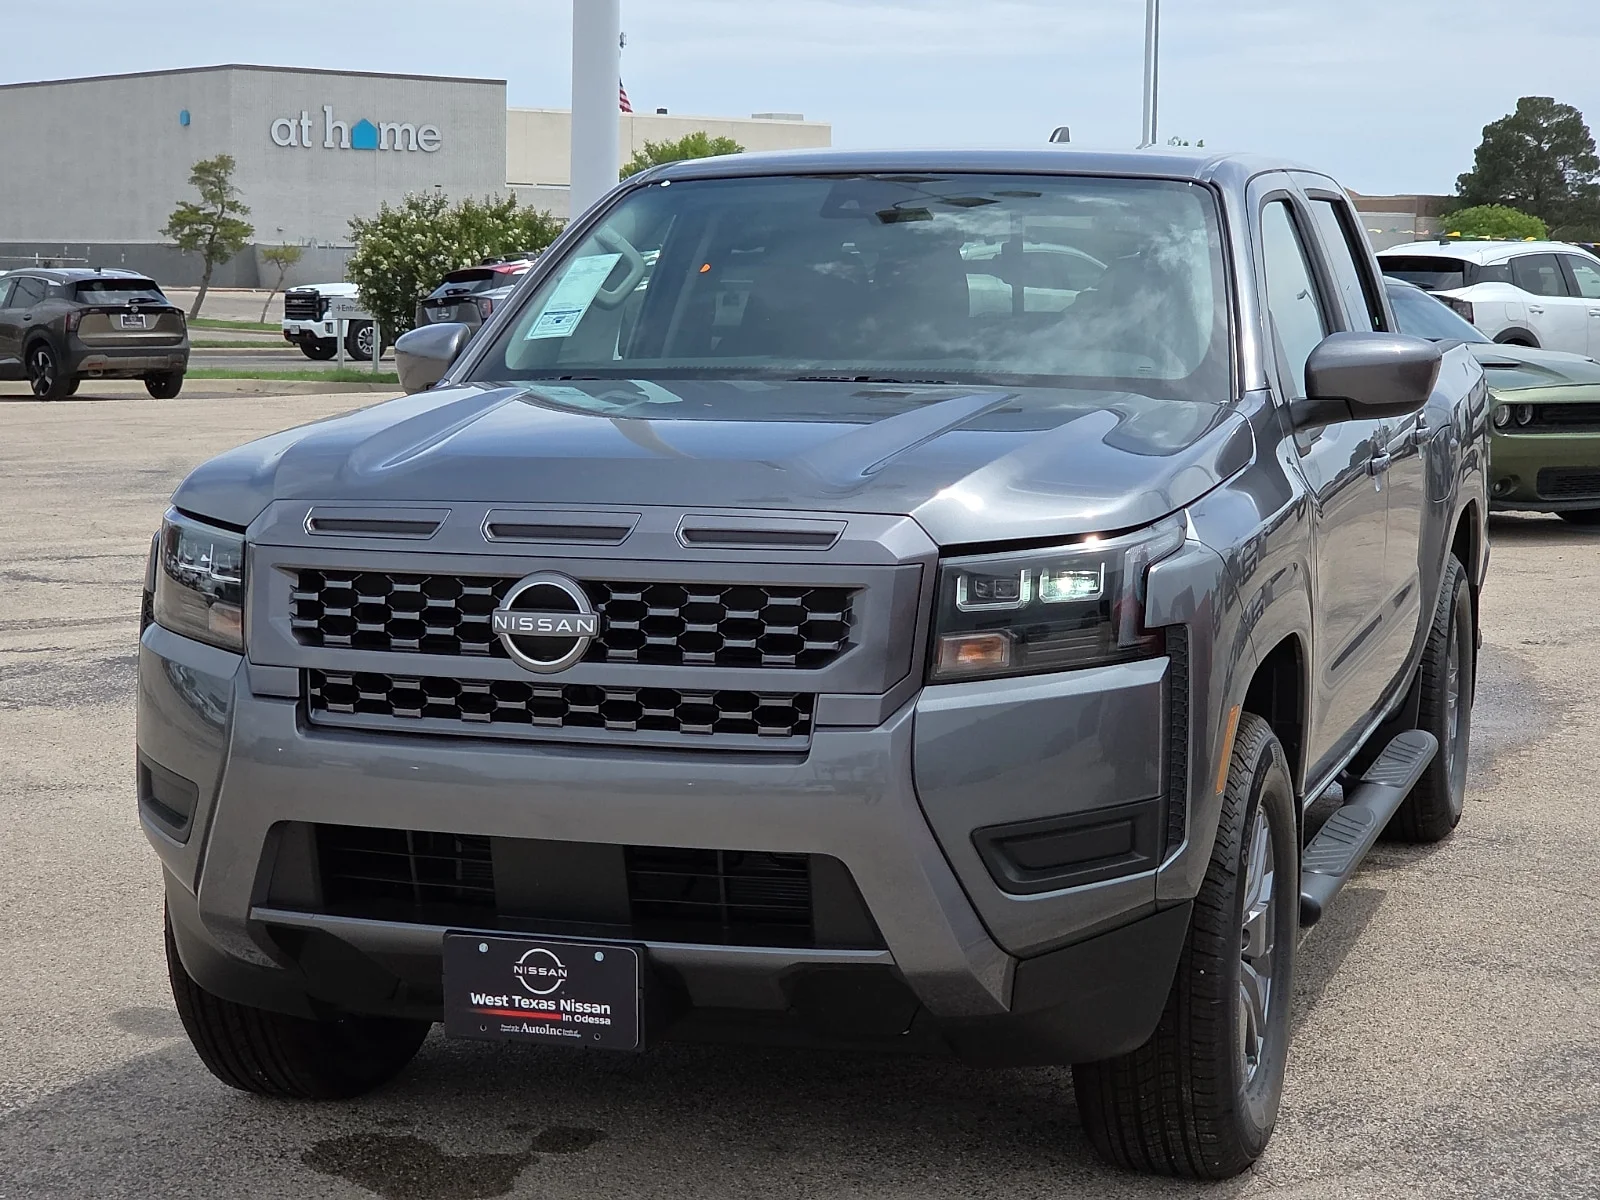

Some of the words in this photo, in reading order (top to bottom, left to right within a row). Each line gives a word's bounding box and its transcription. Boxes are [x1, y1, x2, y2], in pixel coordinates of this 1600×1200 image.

[270, 110, 312, 148] at
[494, 615, 594, 633] NISSAN
[513, 965, 568, 978] NISSAN
[470, 992, 509, 1007] West
[512, 995, 556, 1011] Texas
[560, 999, 611, 1015] Nissan
[562, 1013, 572, 1022] In
[574, 1014, 611, 1026] Odessa
[520, 1022, 562, 1036] AutoInc
